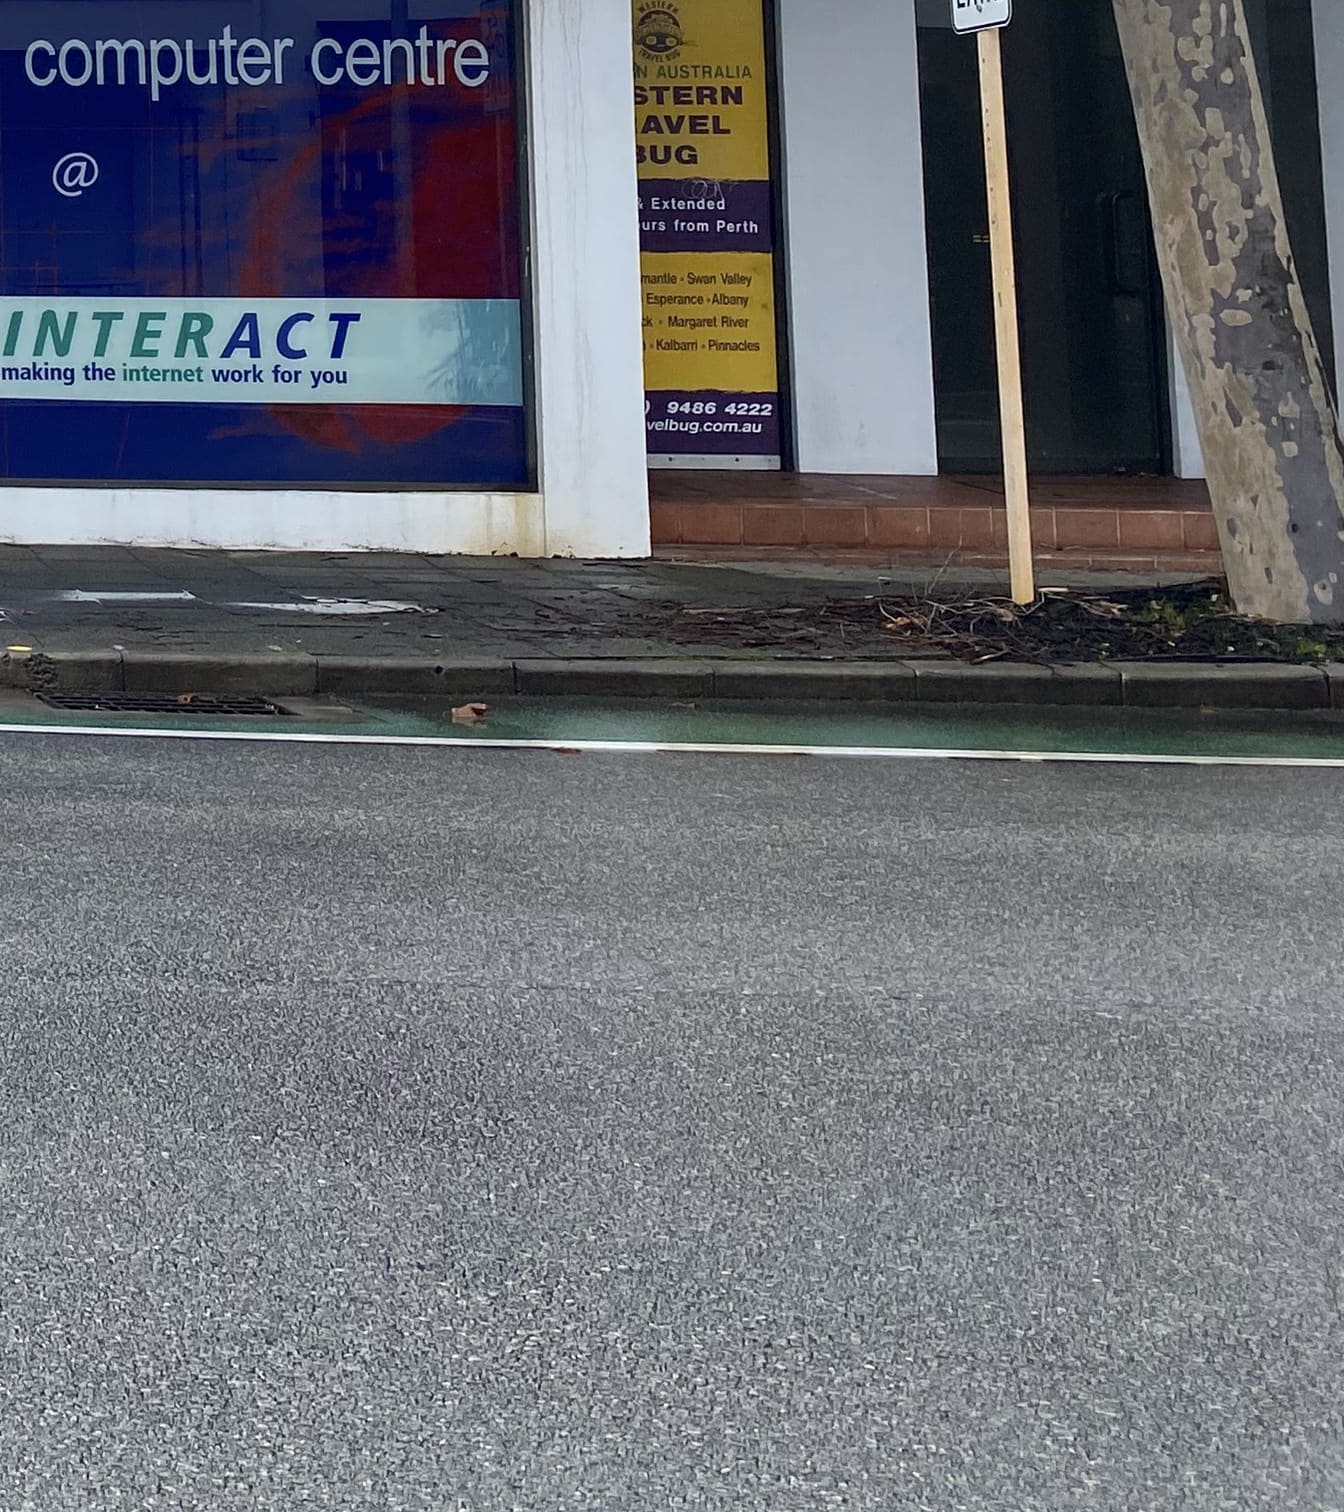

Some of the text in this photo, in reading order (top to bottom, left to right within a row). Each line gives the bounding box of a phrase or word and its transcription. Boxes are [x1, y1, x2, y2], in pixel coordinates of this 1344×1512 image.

[25, 25, 490, 101] computer centre
[656, 65, 752, 79] AUSTRALIA
[52, 152, 99, 198] @
[651, 197, 726, 210] Extended
[674, 219, 709, 232] from
[716, 220, 759, 234] Perth
[687, 272, 716, 285] Swan
[720, 273, 752, 287] Valley
[646, 293, 749, 308] Esperance Albany
[668, 316, 717, 330] Margaret
[721, 316, 749, 328] River
[2, 309, 362, 360] INTERACT
[708, 339, 761, 352] Pinnacles
[1, 362, 348, 388] making the internet work for you
[667, 401, 773, 416] 9486 4222
[647, 419, 762, 434] velbug.com.au
